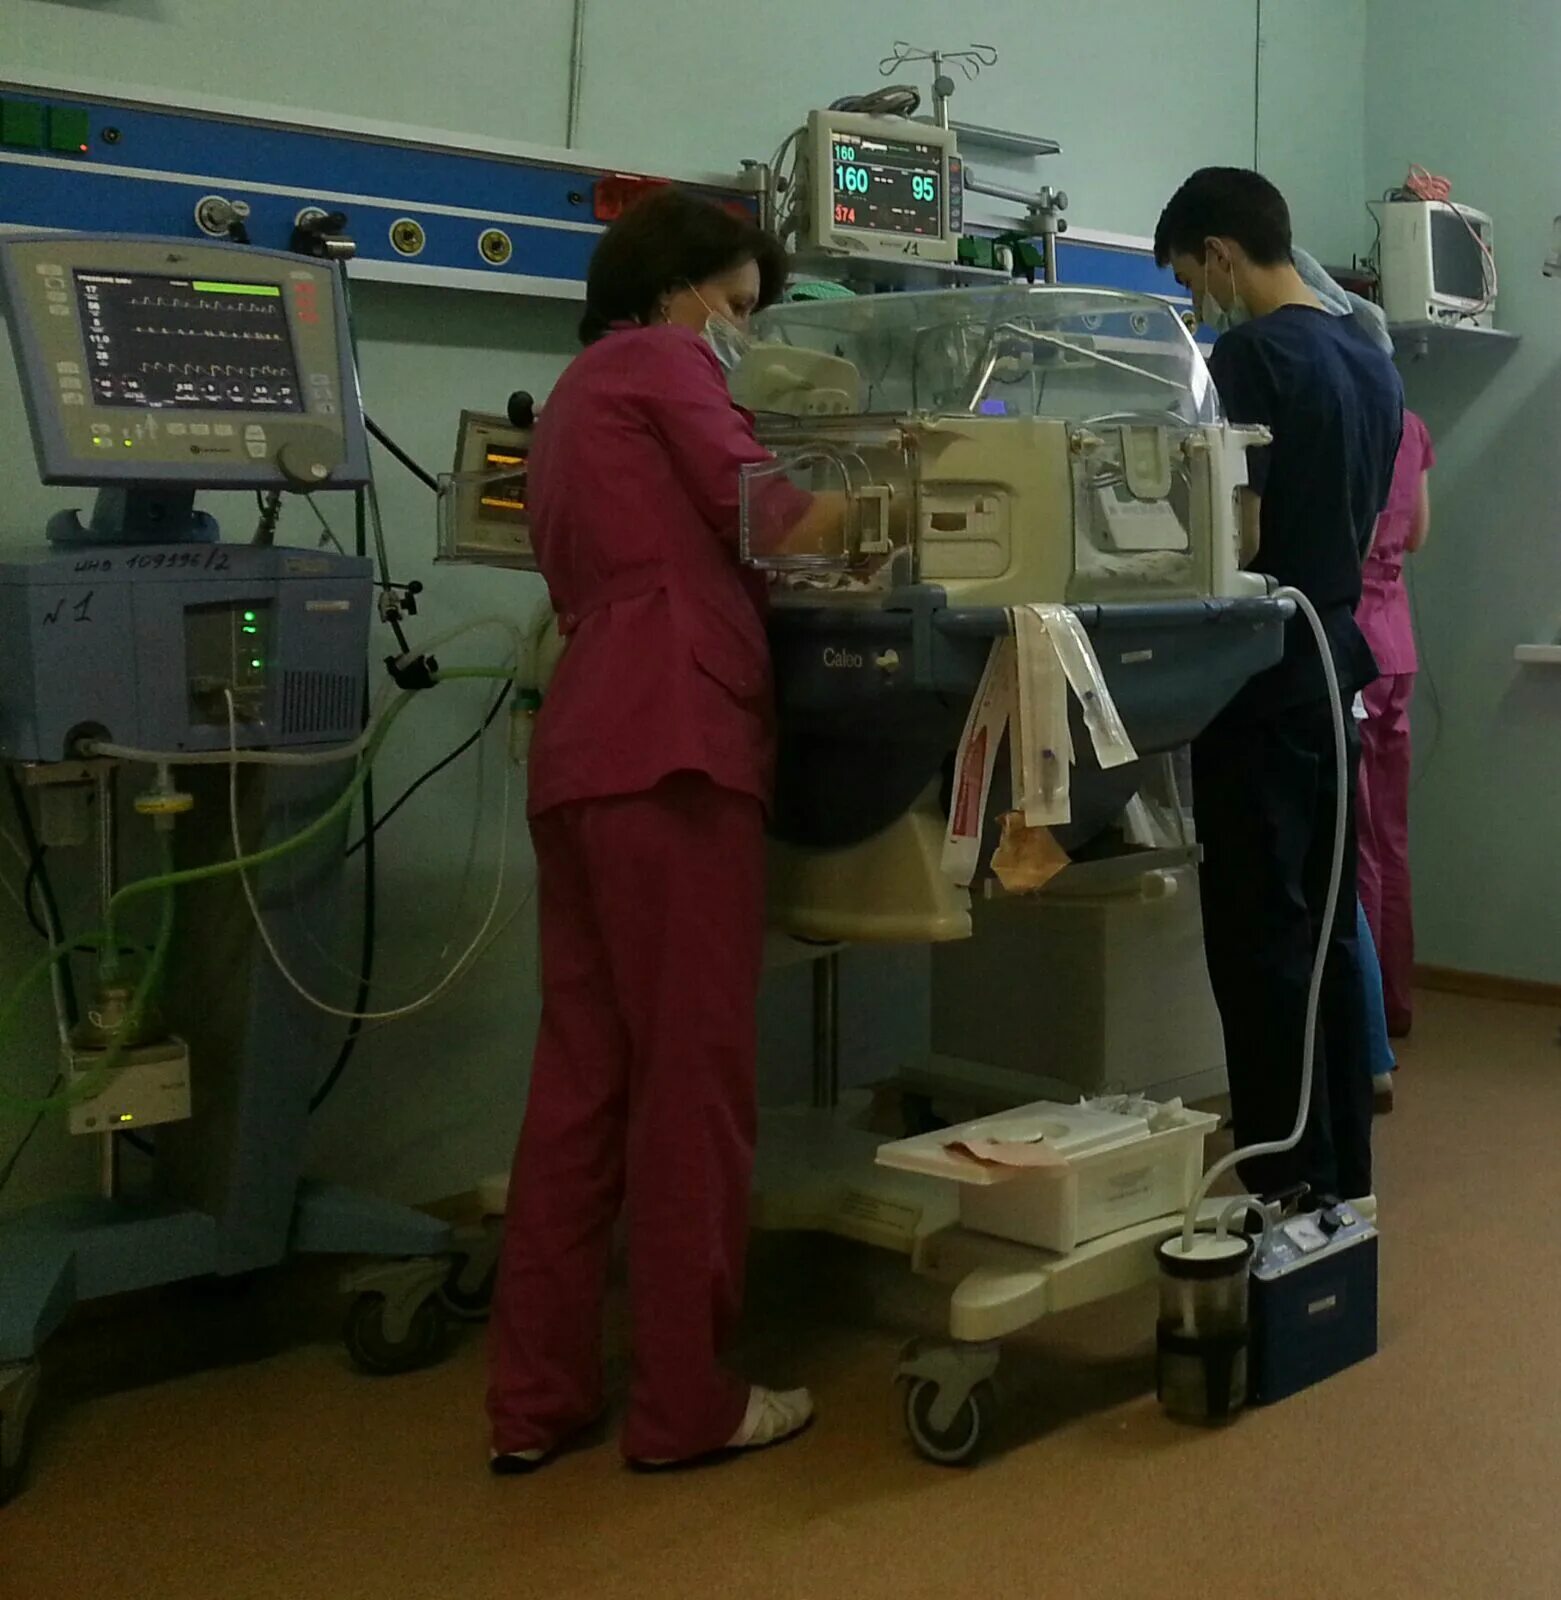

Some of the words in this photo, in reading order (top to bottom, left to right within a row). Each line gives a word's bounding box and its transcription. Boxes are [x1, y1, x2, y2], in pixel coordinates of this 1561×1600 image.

[835, 144, 855, 161] 160
[836, 165, 869, 193] 160
[912, 176, 934, 202] 95
[73, 591, 94, 622] 1
[823, 647, 863, 668] Caleo
